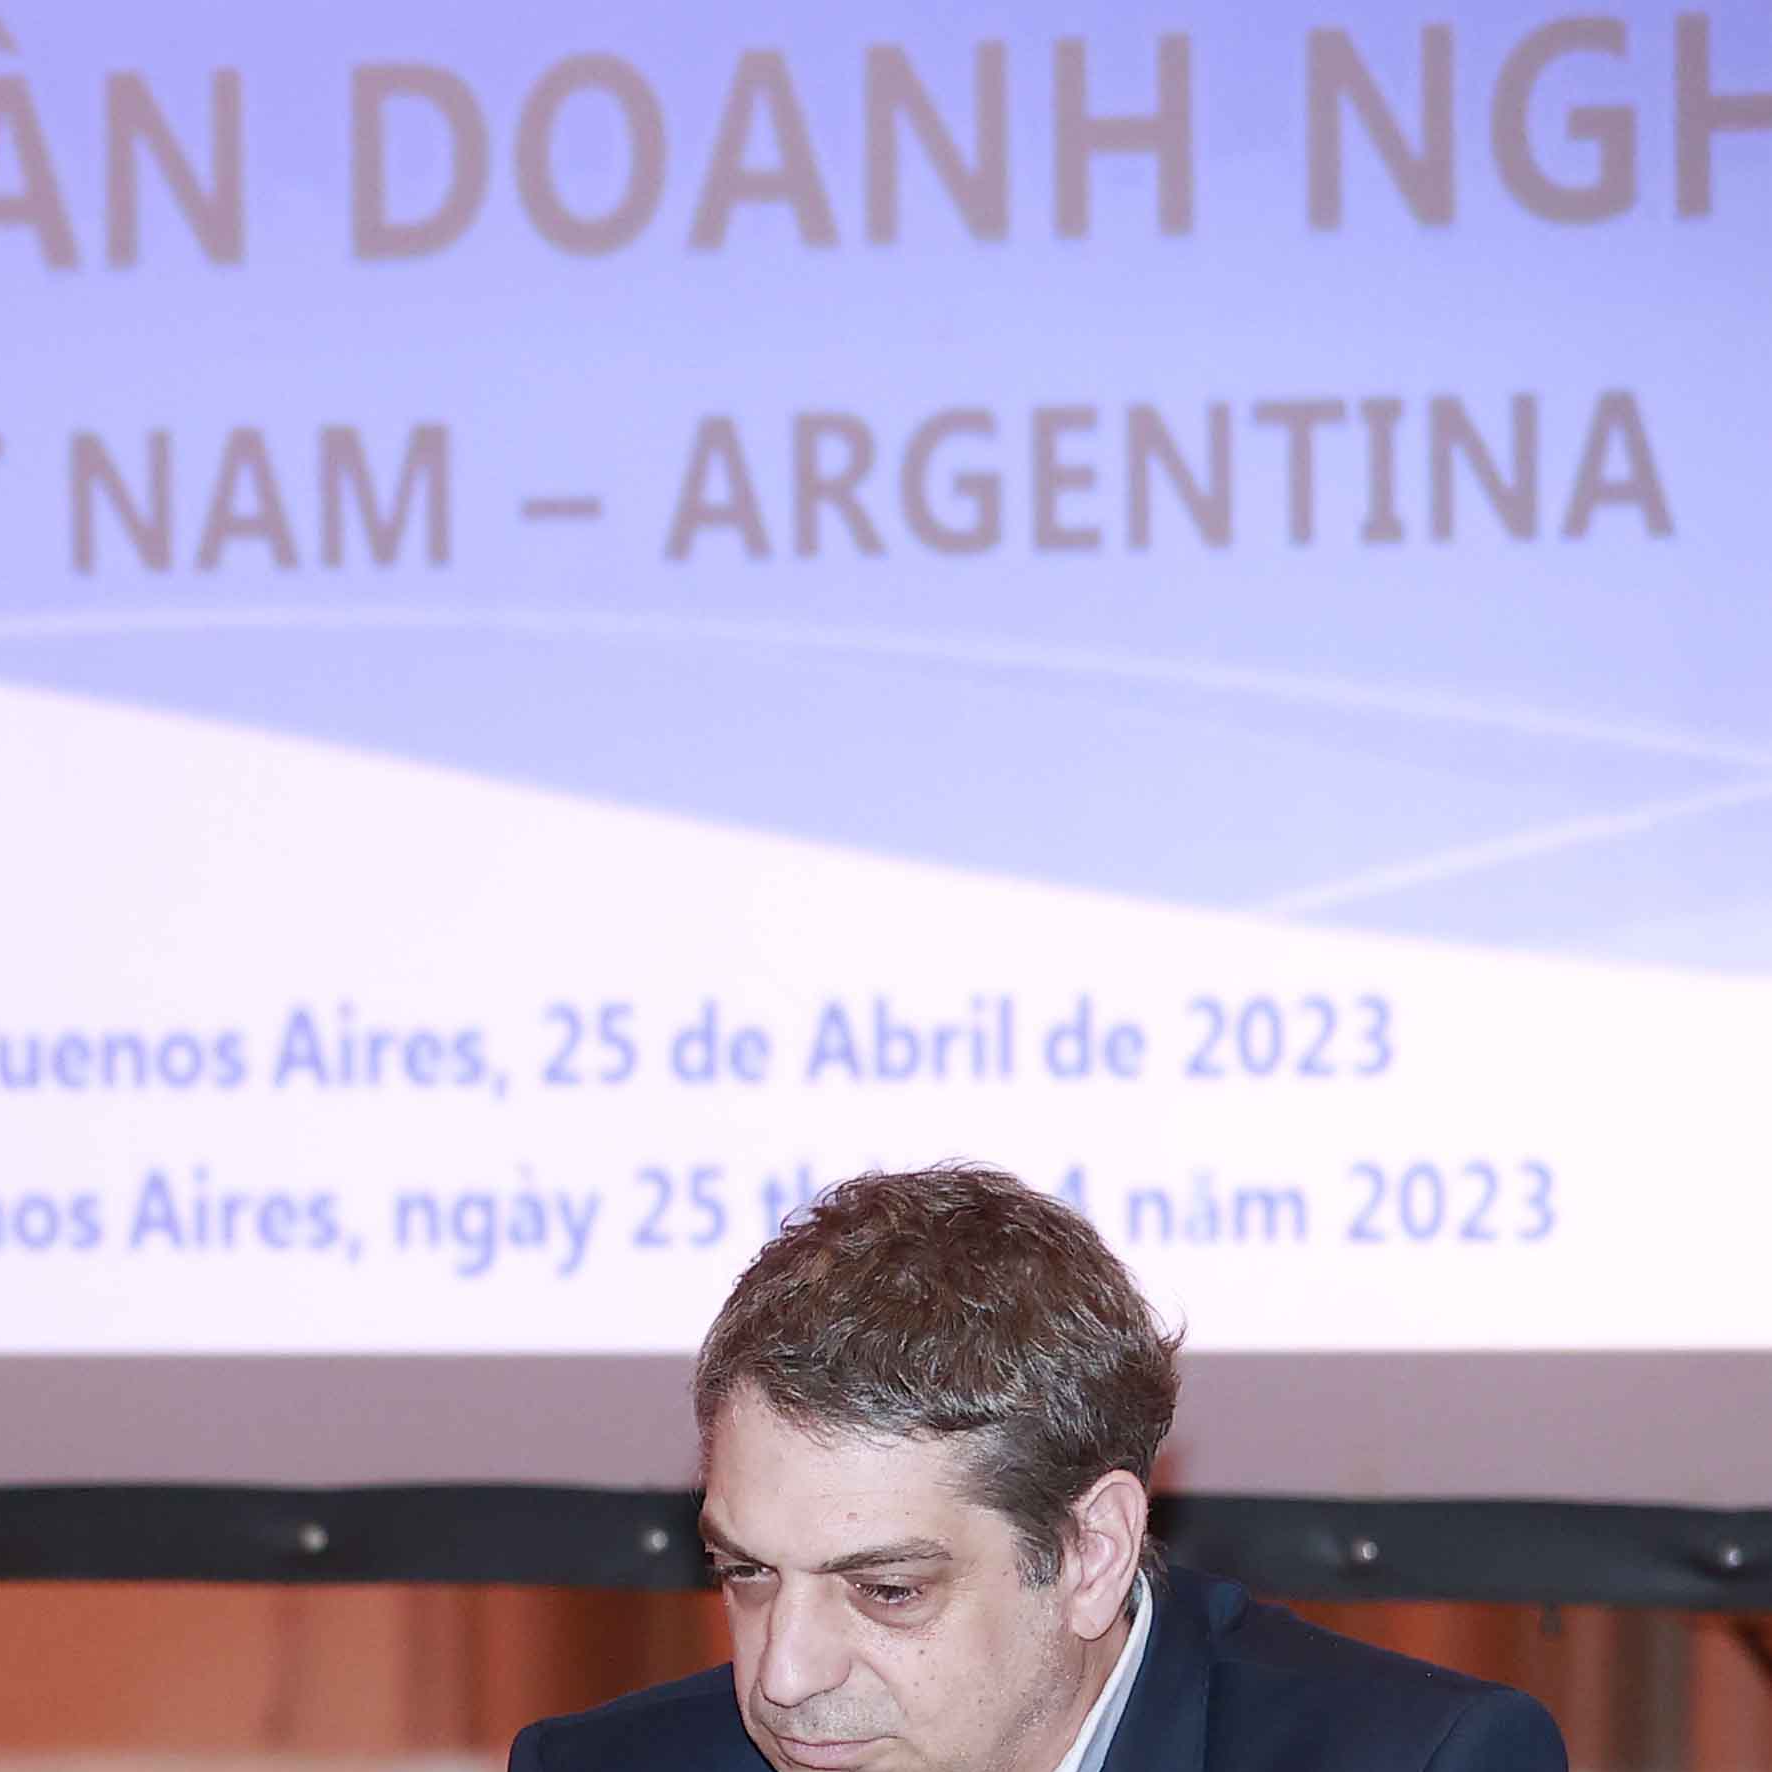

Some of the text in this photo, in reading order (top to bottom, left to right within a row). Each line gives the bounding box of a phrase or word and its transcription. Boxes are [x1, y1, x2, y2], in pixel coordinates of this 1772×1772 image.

[345, 24, 1203, 264] DOANH
[69, 423, 450, 576] NAM
[663, 386, 1676, 563] ARGENTINA
[273, 1005, 506, 1096] Aires,
[541, 1001, 637, 1088] 25
[670, 1000, 771, 1084] de
[806, 995, 1012, 1080] Abril
[1043, 993, 1145, 1080] de
[1185, 995, 1393, 1078] 2023
[129, 1168, 361, 1261] Aires,
[393, 1162, 601, 1279] ngày
[633, 1167, 727, 1248] 25
[1348, 1160, 1555, 1243] 2023
